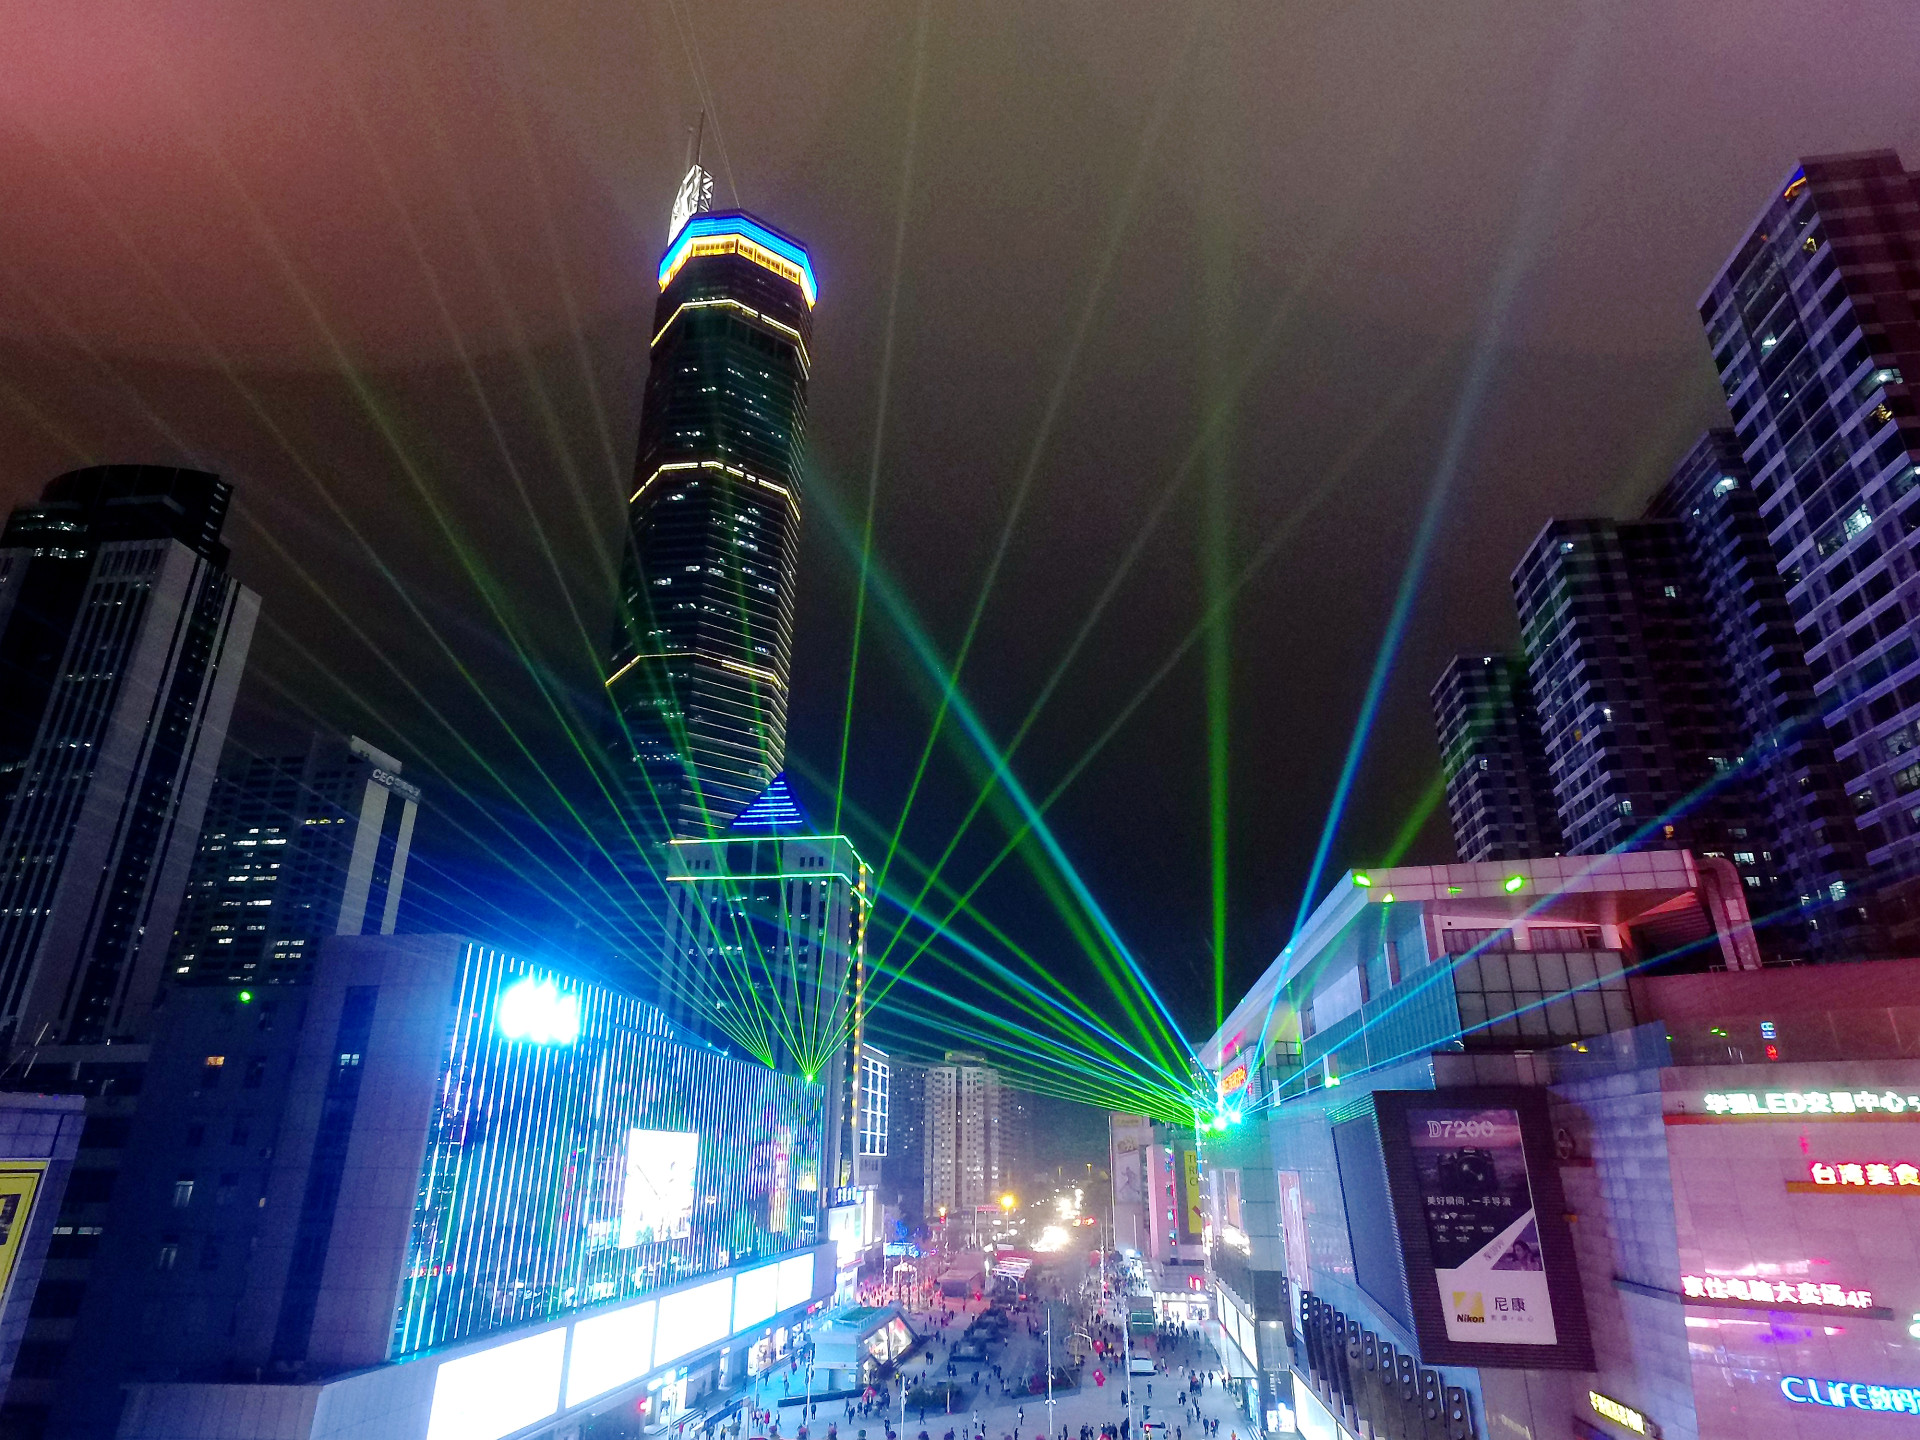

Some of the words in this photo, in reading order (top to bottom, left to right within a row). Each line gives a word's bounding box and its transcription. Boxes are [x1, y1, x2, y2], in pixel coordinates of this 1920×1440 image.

[372, 768, 395, 786] CEC
[1427, 1120, 1495, 1138] D7200
[1494, 1296, 1526, 1312] 尼康
[1456, 1313, 1485, 1324] Nikon
